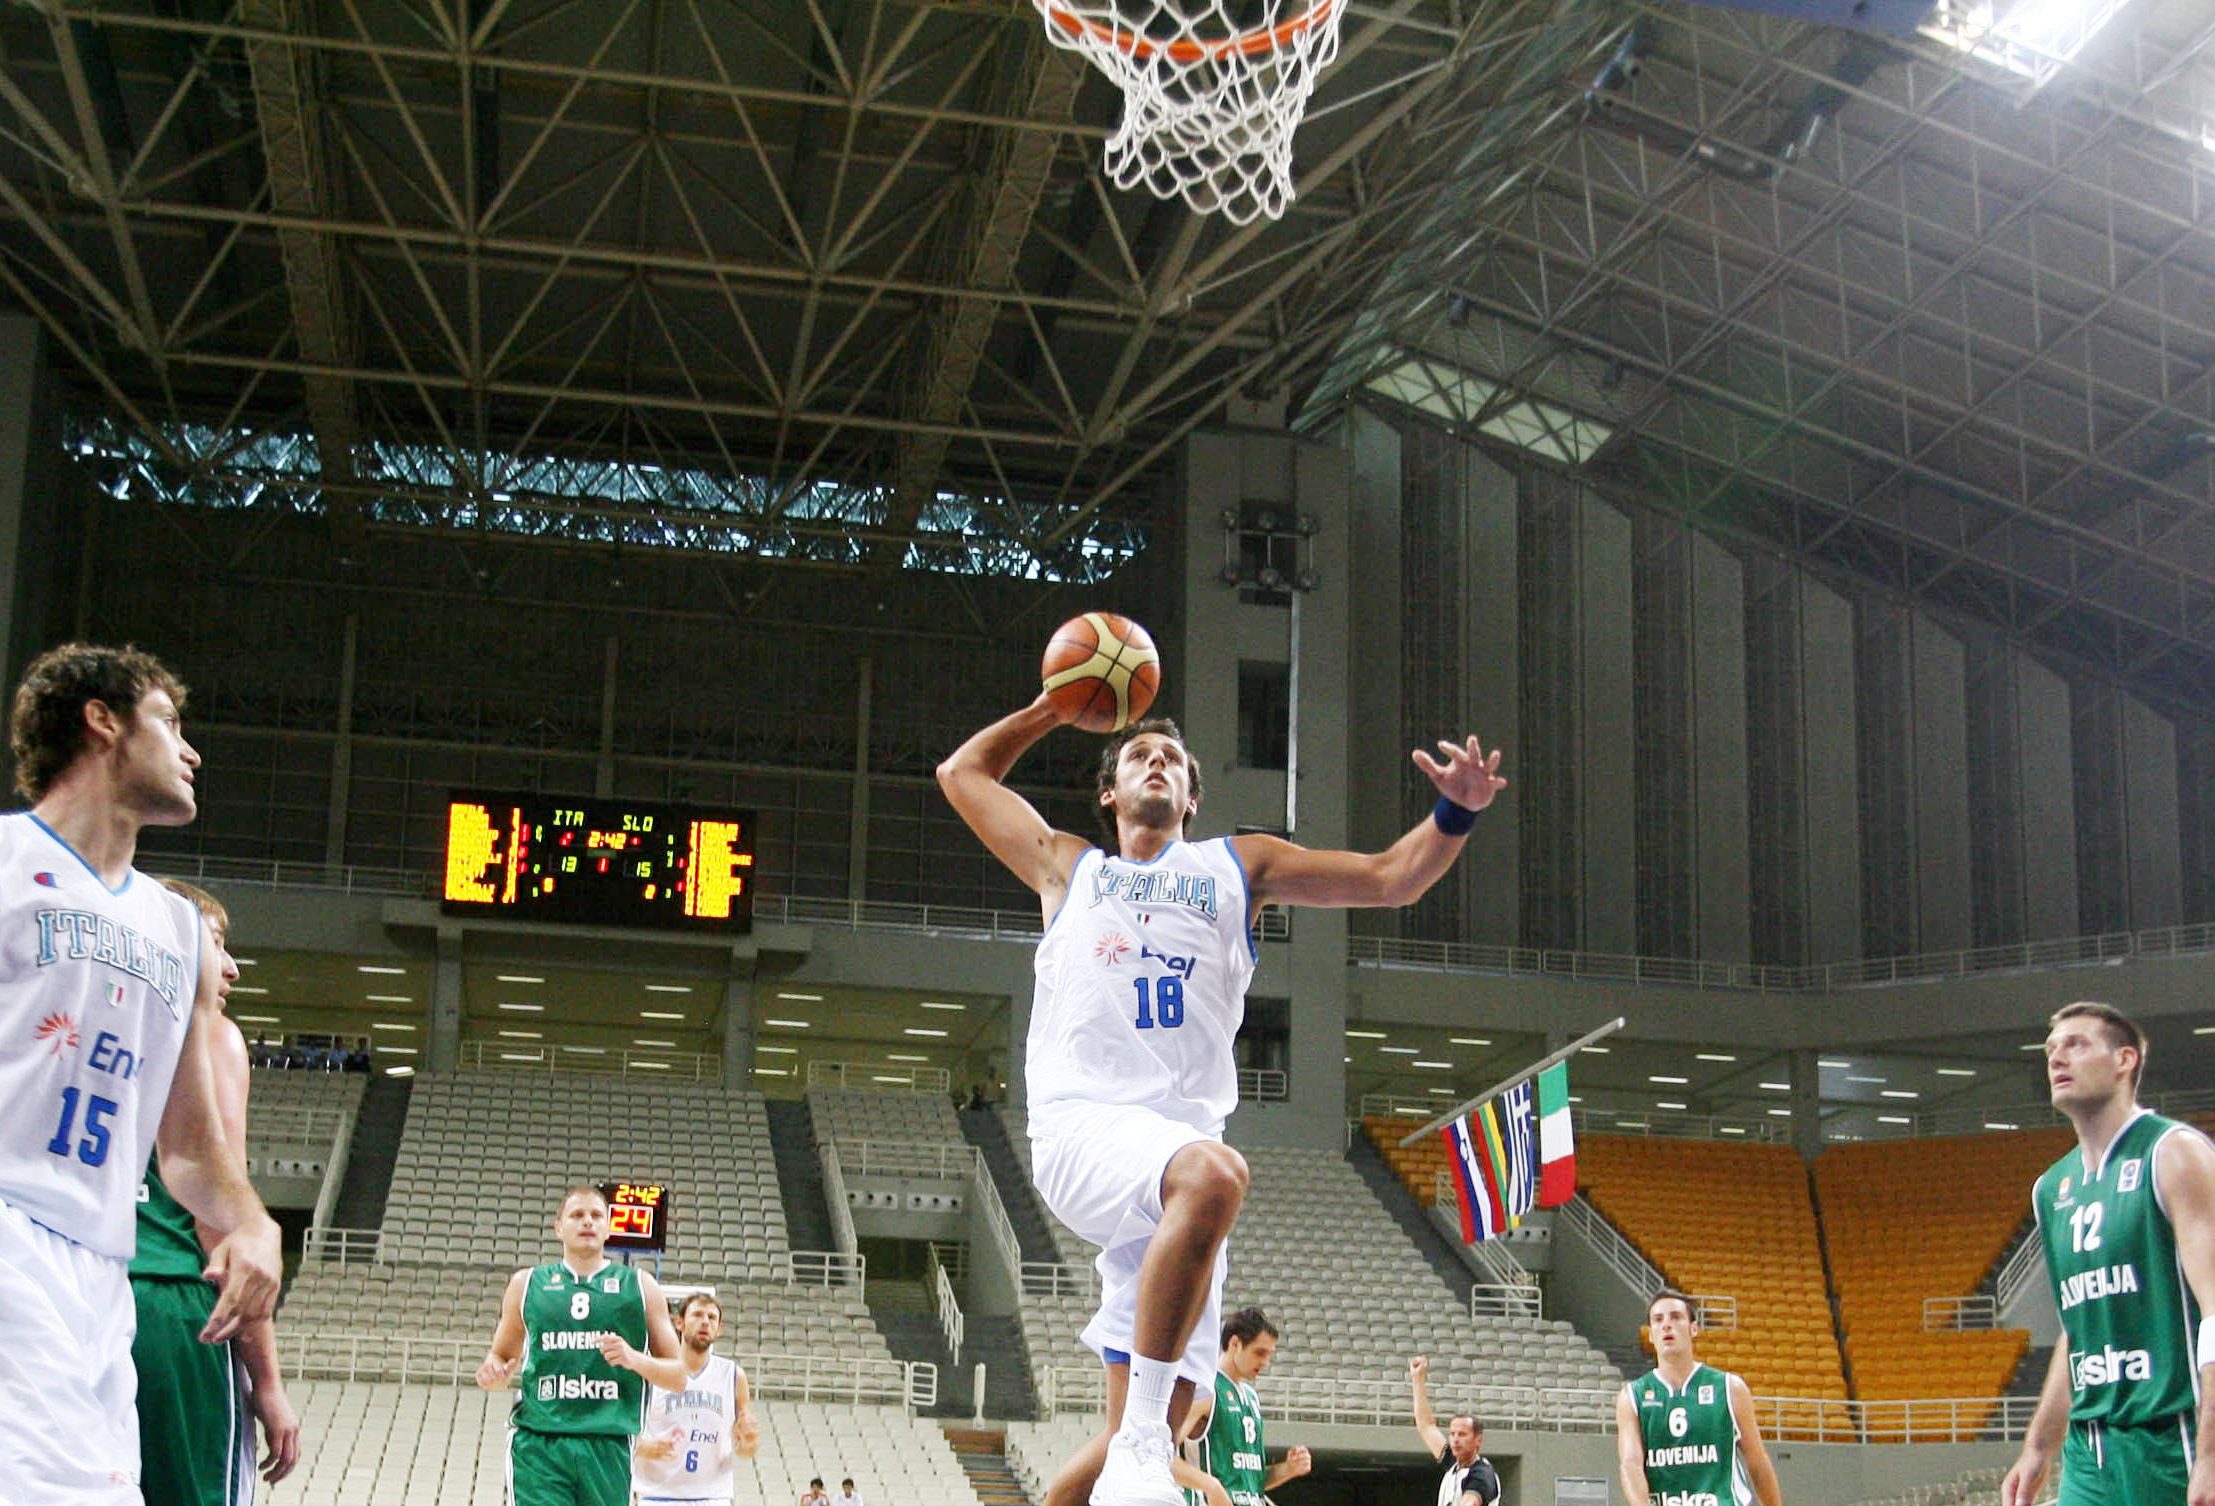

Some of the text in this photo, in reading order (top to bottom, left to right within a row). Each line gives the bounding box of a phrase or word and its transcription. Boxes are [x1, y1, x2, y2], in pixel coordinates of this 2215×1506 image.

[553, 810, 584, 827] ITA
[622, 815, 653, 832] SLO
[588, 831, 626, 849] 2:42
[561, 856, 577, 872] 13
[636, 862, 651, 878] 15
[1089, 865, 1217, 921] ITALIA
[36, 908, 187, 1022] ITALIA
[1141, 944, 1197, 980] Eel
[1133, 976, 1184, 1029] 18
[48, 1086, 118, 1168] 15
[615, 1184, 660, 1205] 2:42
[610, 1207, 650, 1233] 24
[2070, 1201, 2104, 1254] 12
[571, 1292, 590, 1320] 8
[559, 1373, 619, 1400] Iskra
[1668, 1407, 1688, 1437] 6
[690, 1429, 719, 1444] Enel
[685, 1450, 699, 1473] 6
[1646, 1444, 1718, 1467] LOVENIJA
